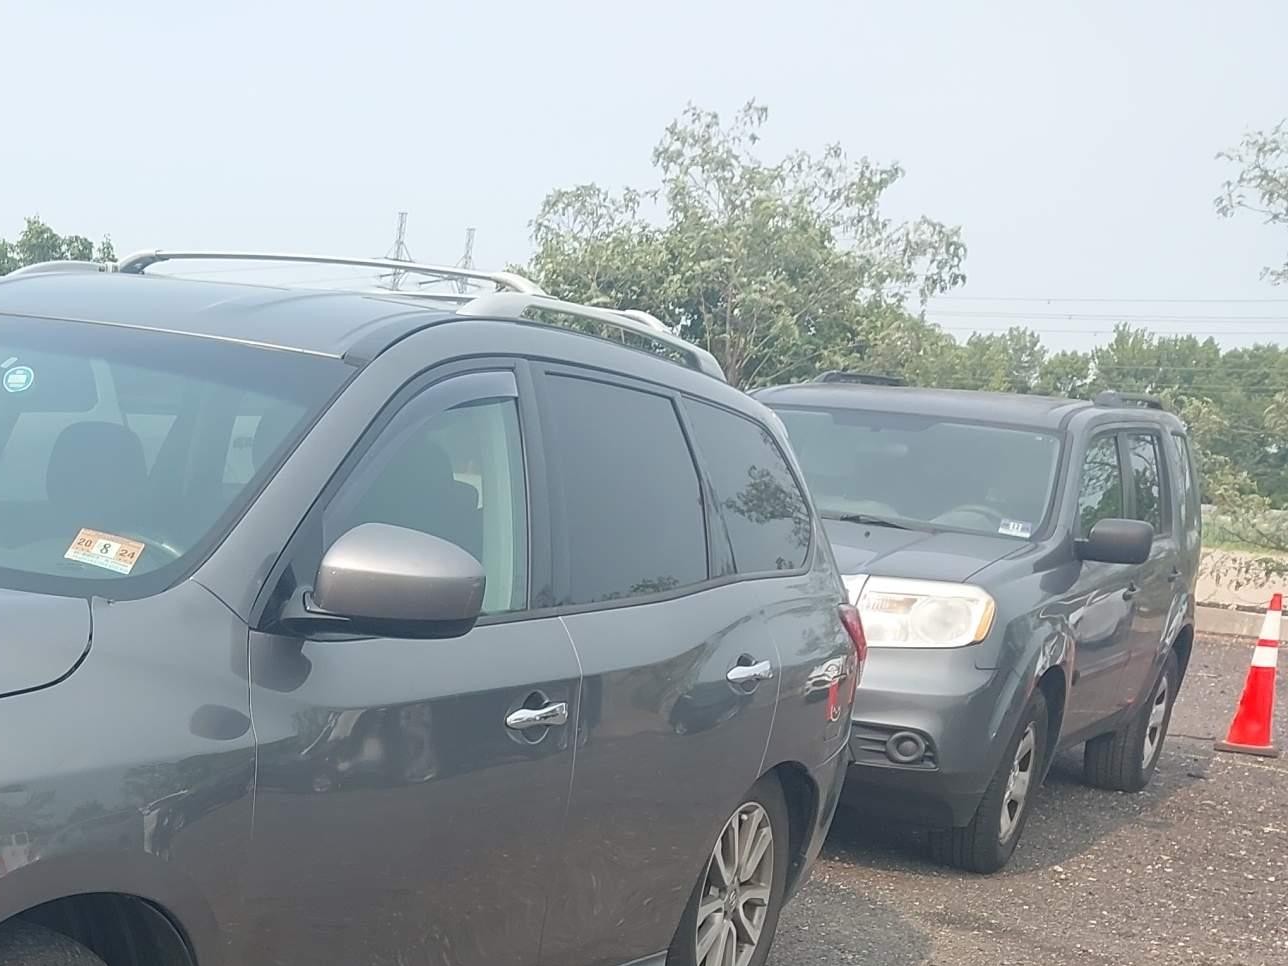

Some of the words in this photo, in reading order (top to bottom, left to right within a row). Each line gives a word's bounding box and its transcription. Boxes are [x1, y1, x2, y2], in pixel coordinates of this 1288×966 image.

[77, 537, 93, 548] 20
[100, 543, 111, 554] 8
[119, 549, 136, 560] 24
